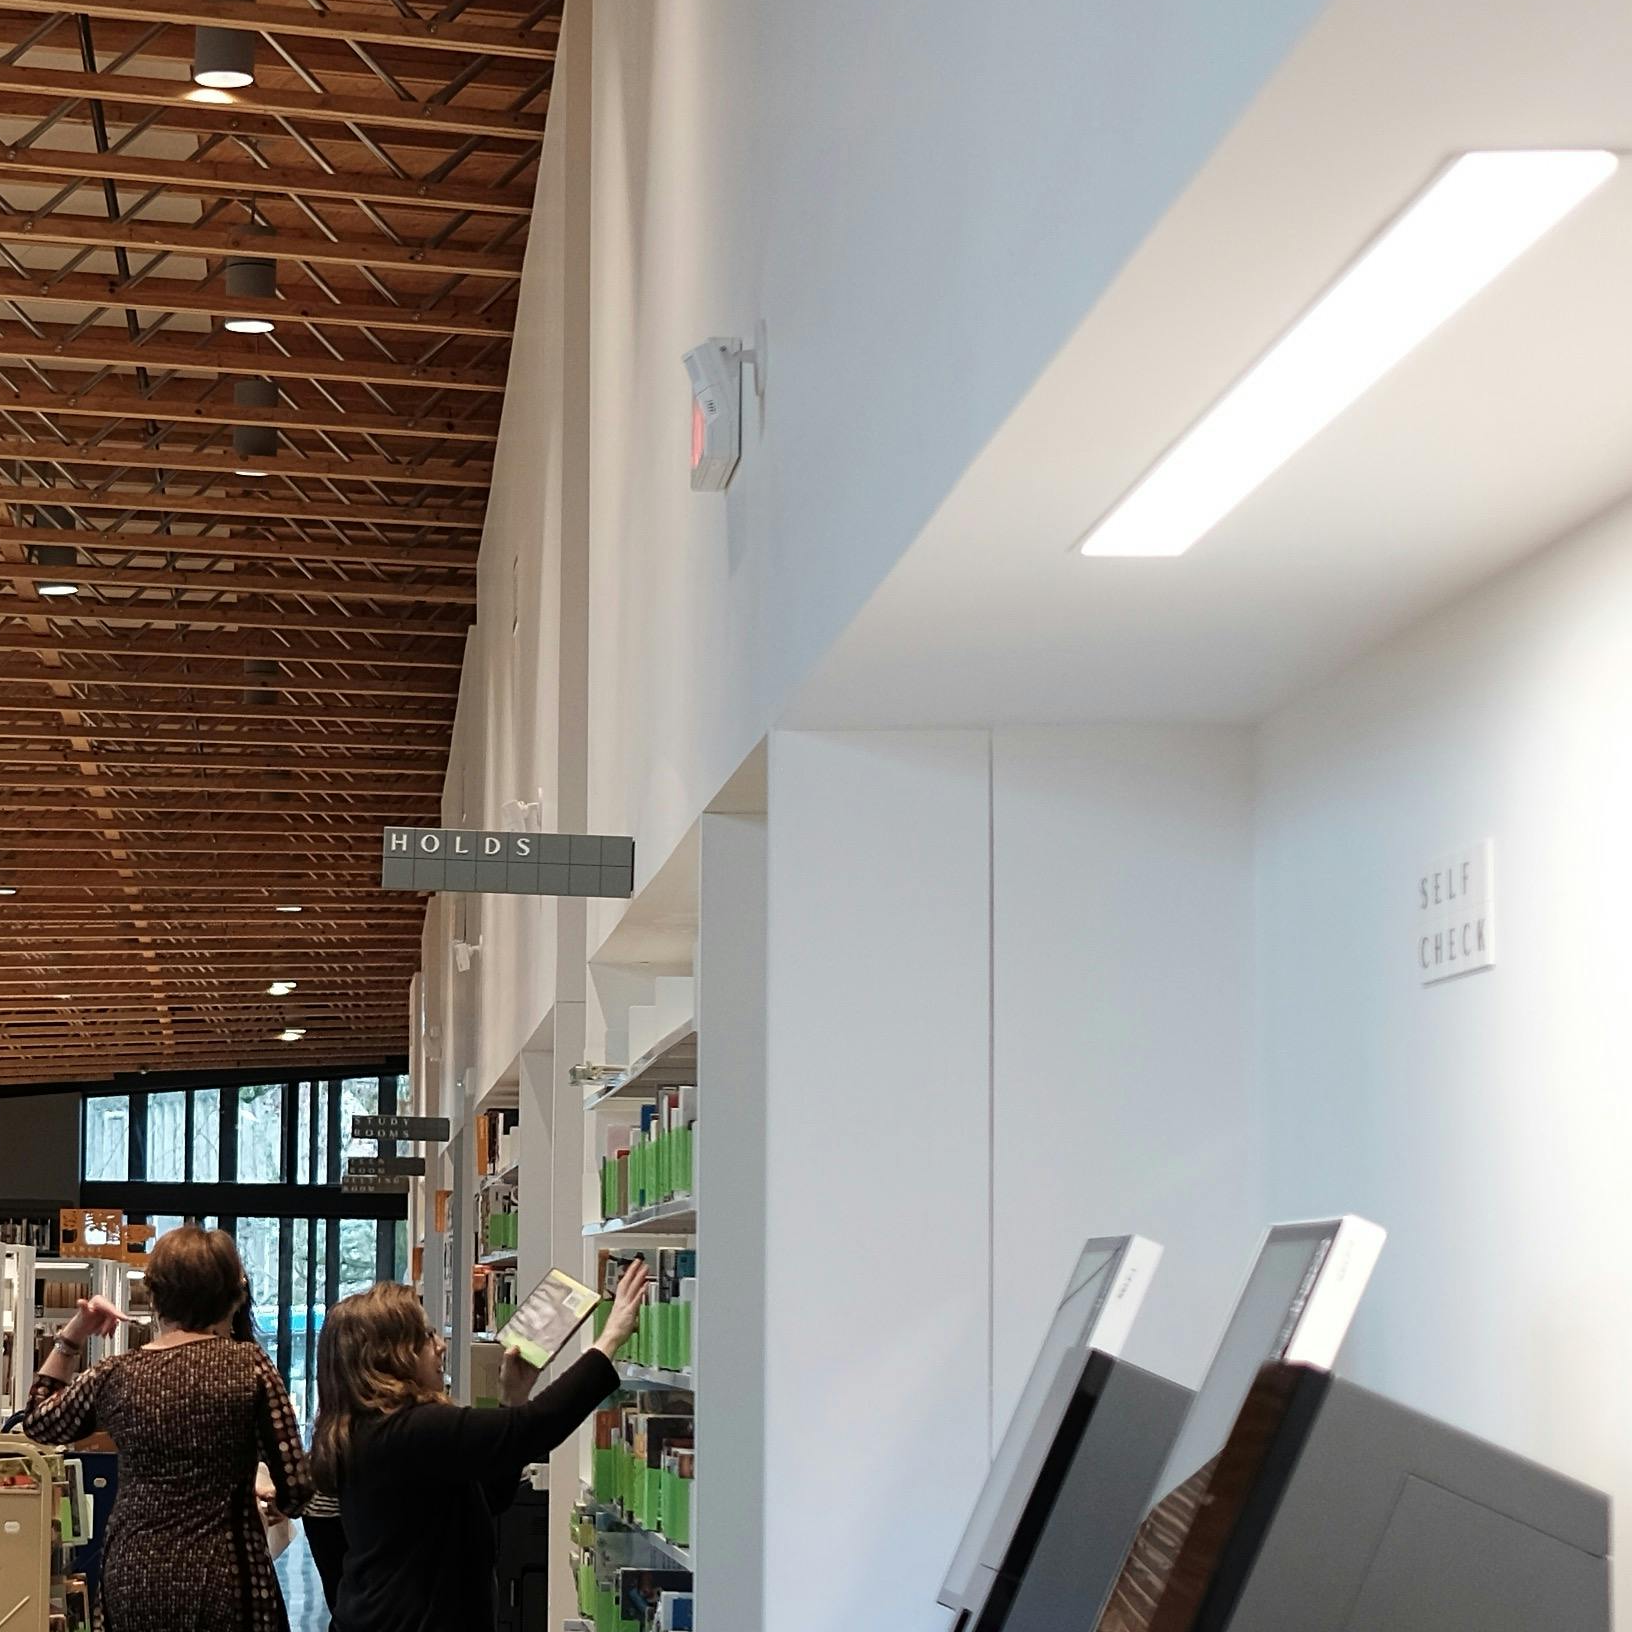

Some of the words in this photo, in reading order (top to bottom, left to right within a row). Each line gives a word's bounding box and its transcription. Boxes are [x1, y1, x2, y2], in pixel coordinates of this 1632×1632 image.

[390, 832, 532, 857] HOLDS
[1418, 861, 1472, 910] SELF
[1418, 917, 1488, 969] CHECK
[354, 1116, 411, 1126] STUDY
[354, 1129, 410, 1138] ROOMS
